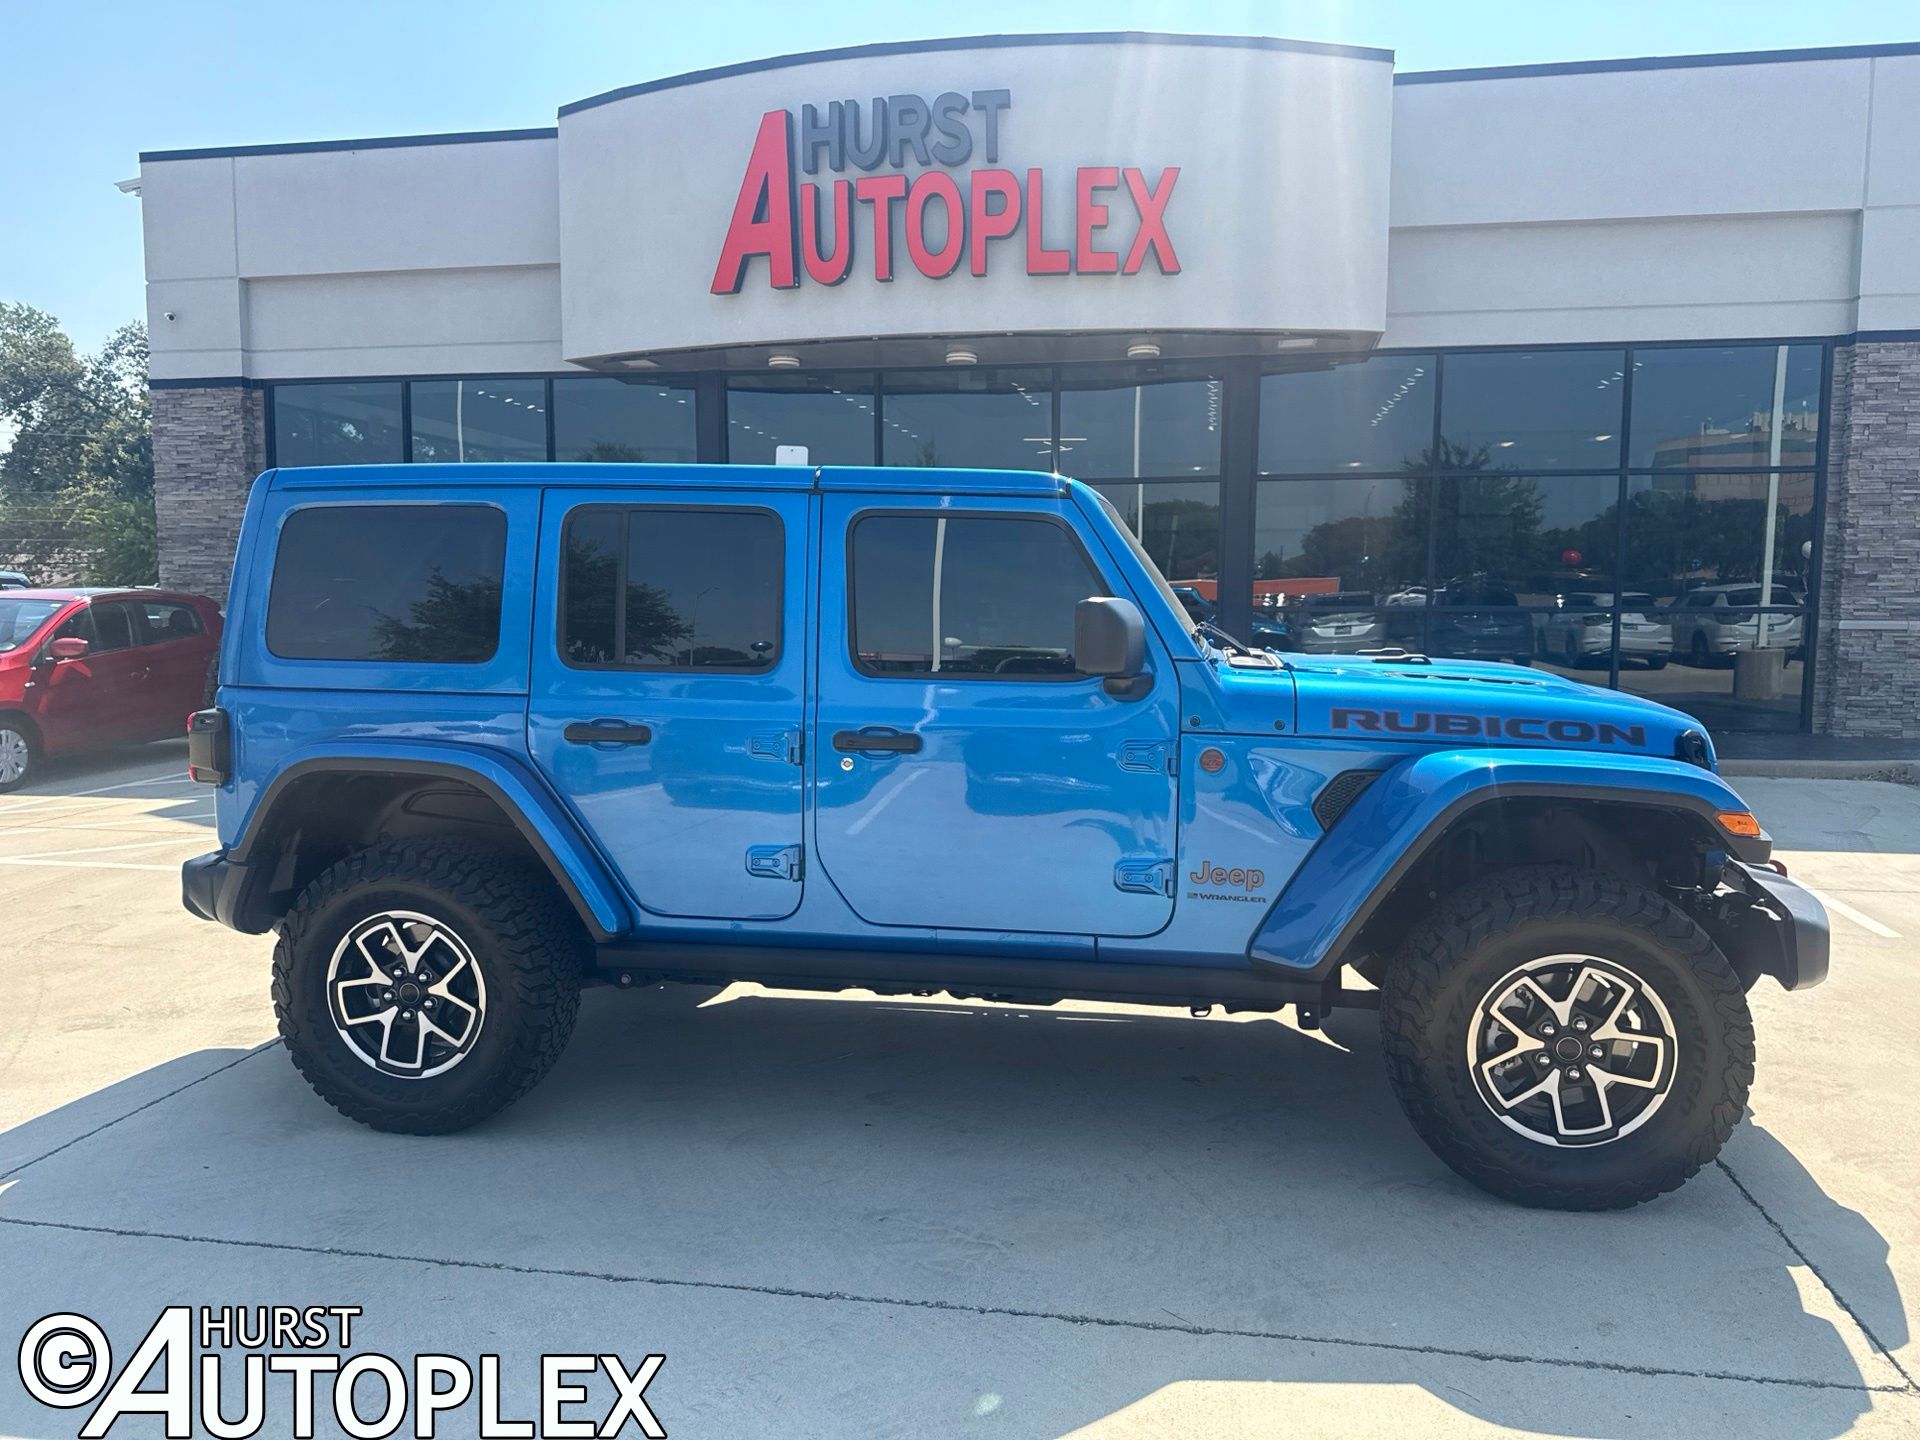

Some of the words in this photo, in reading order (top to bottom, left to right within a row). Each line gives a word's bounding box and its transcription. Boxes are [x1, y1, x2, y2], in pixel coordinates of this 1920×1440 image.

[802, 89, 1011, 174] HURST
[710, 109, 1182, 295] AUTOPLEX
[1330, 708, 1647, 747] RUBICON
[1190, 860, 1265, 892] Jeep
[1199, 892, 1267, 903] WRANGLER
